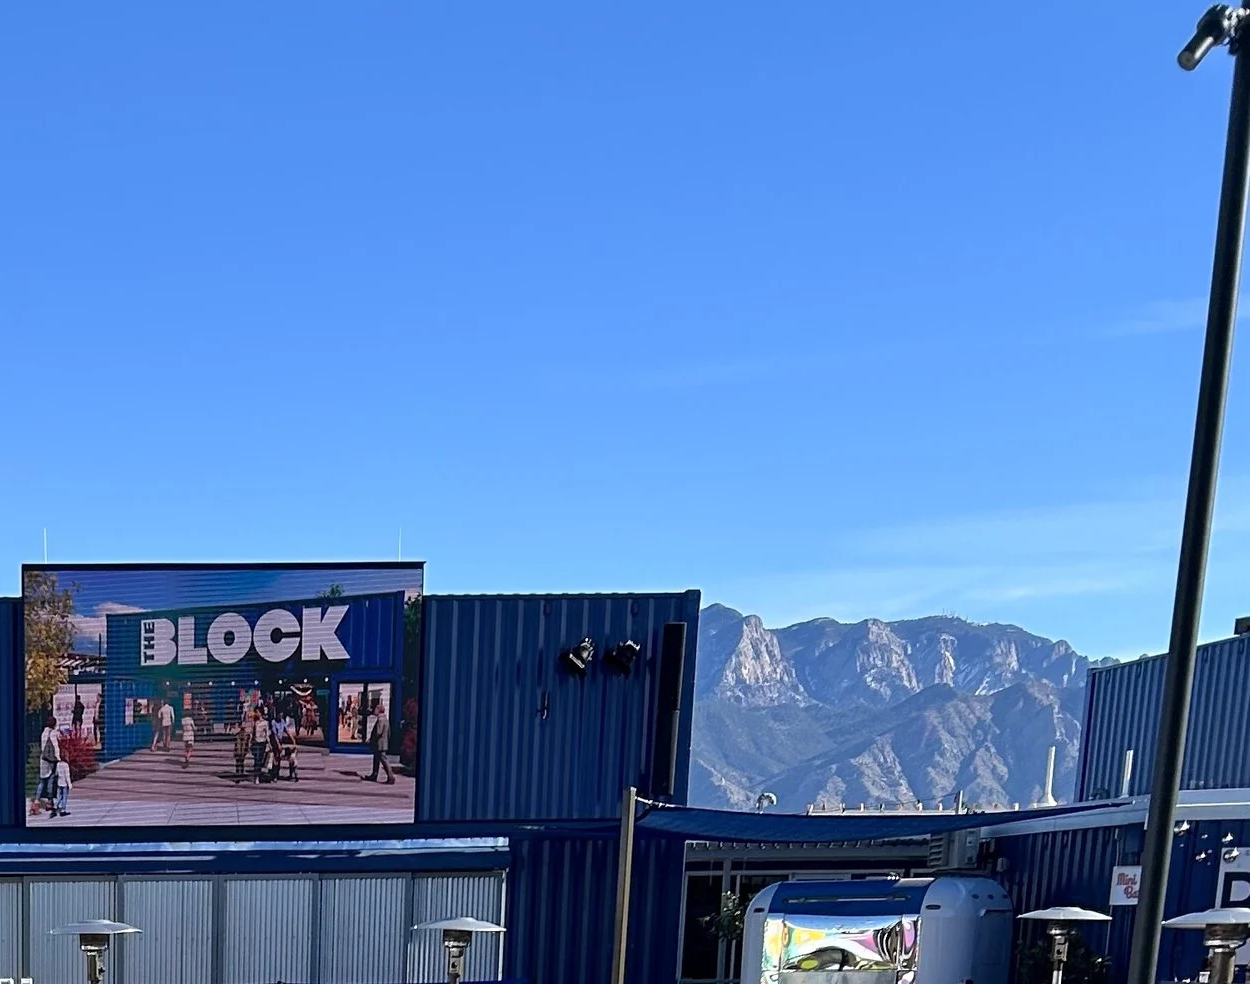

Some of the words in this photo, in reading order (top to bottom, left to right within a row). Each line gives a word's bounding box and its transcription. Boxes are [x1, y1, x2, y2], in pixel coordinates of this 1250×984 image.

[141, 604, 350, 666] BLOCK
[143, 621, 155, 664] THE
[1124, 885, 1139, 899] Ba
